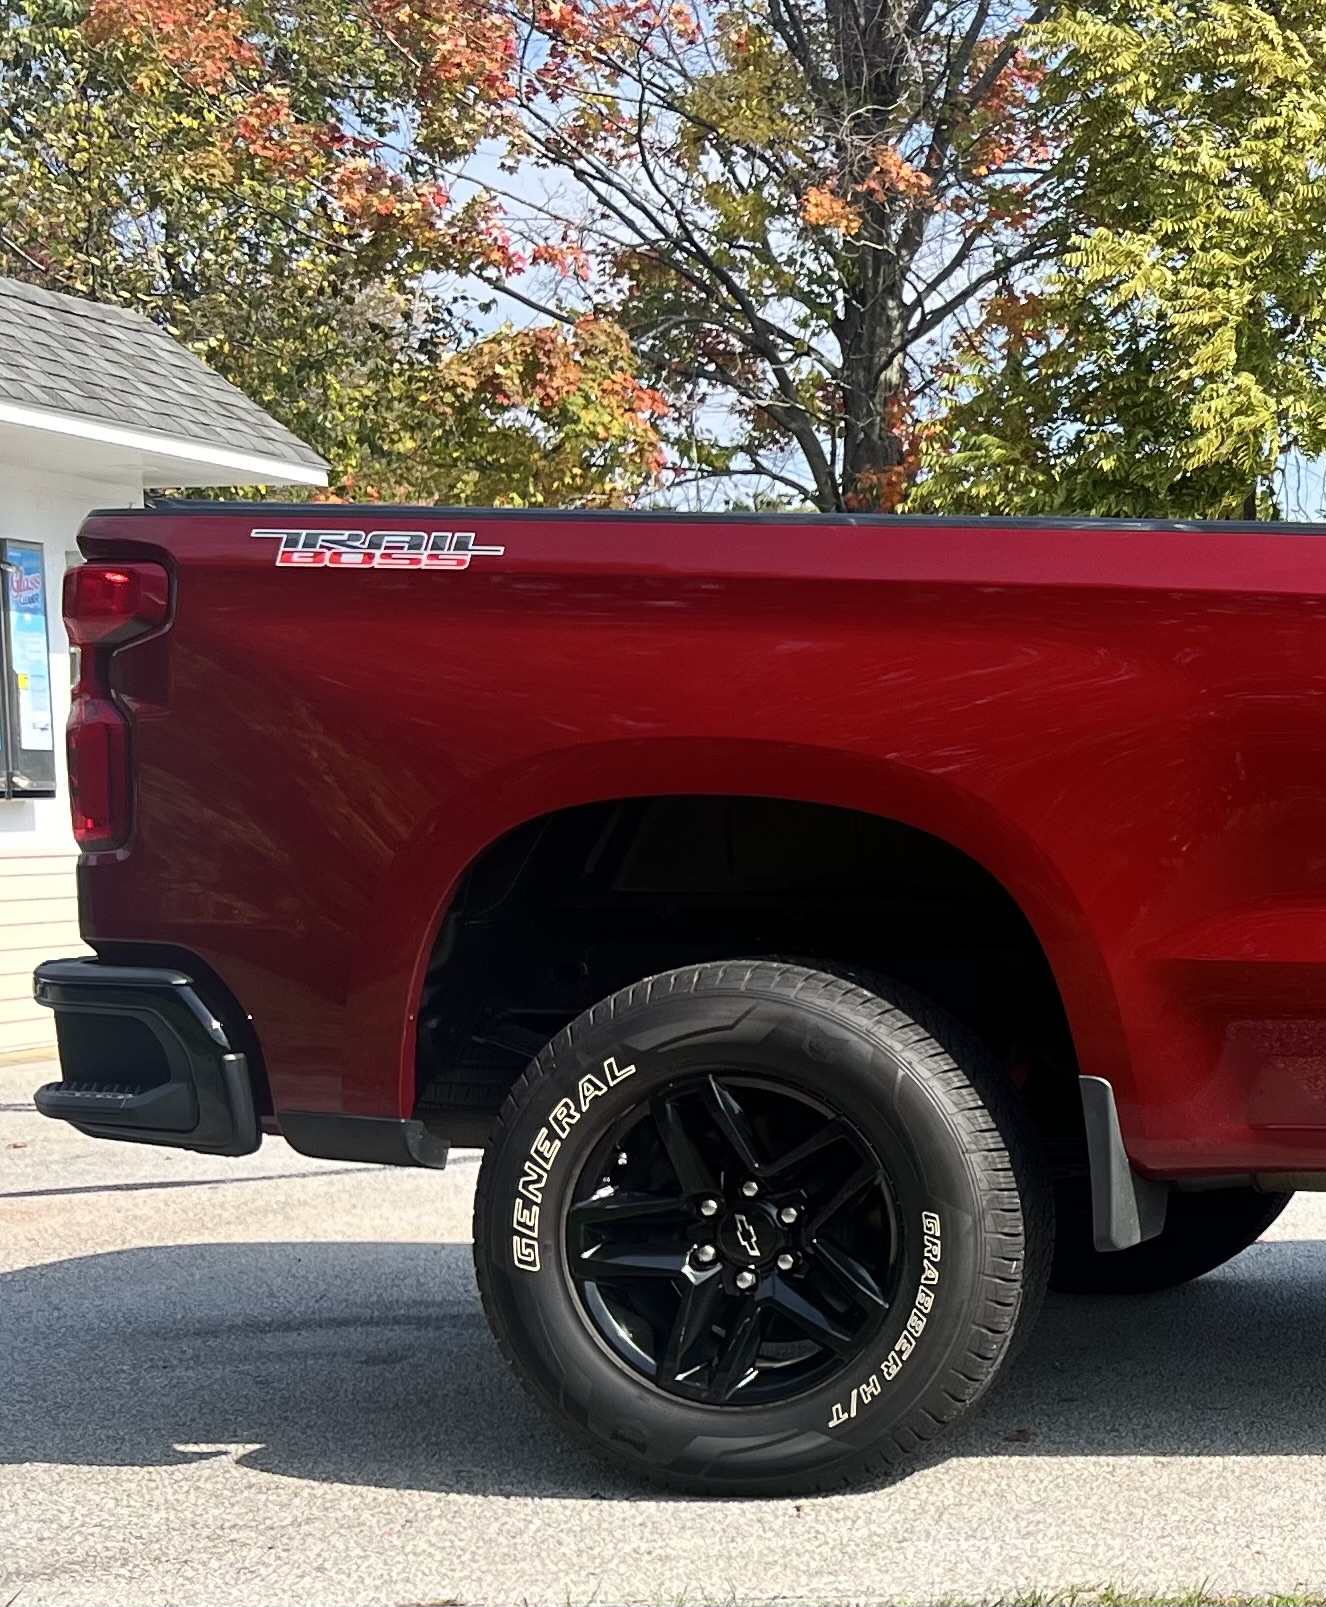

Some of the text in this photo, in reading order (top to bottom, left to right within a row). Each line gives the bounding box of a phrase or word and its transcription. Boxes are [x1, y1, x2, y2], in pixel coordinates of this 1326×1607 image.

[251, 528, 505, 555] TRAIL
[275, 549, 471, 570] BOSS
[512, 1056, 637, 1272] GENERAL
[828, 1210, 942, 1428] GRABBER H/T
